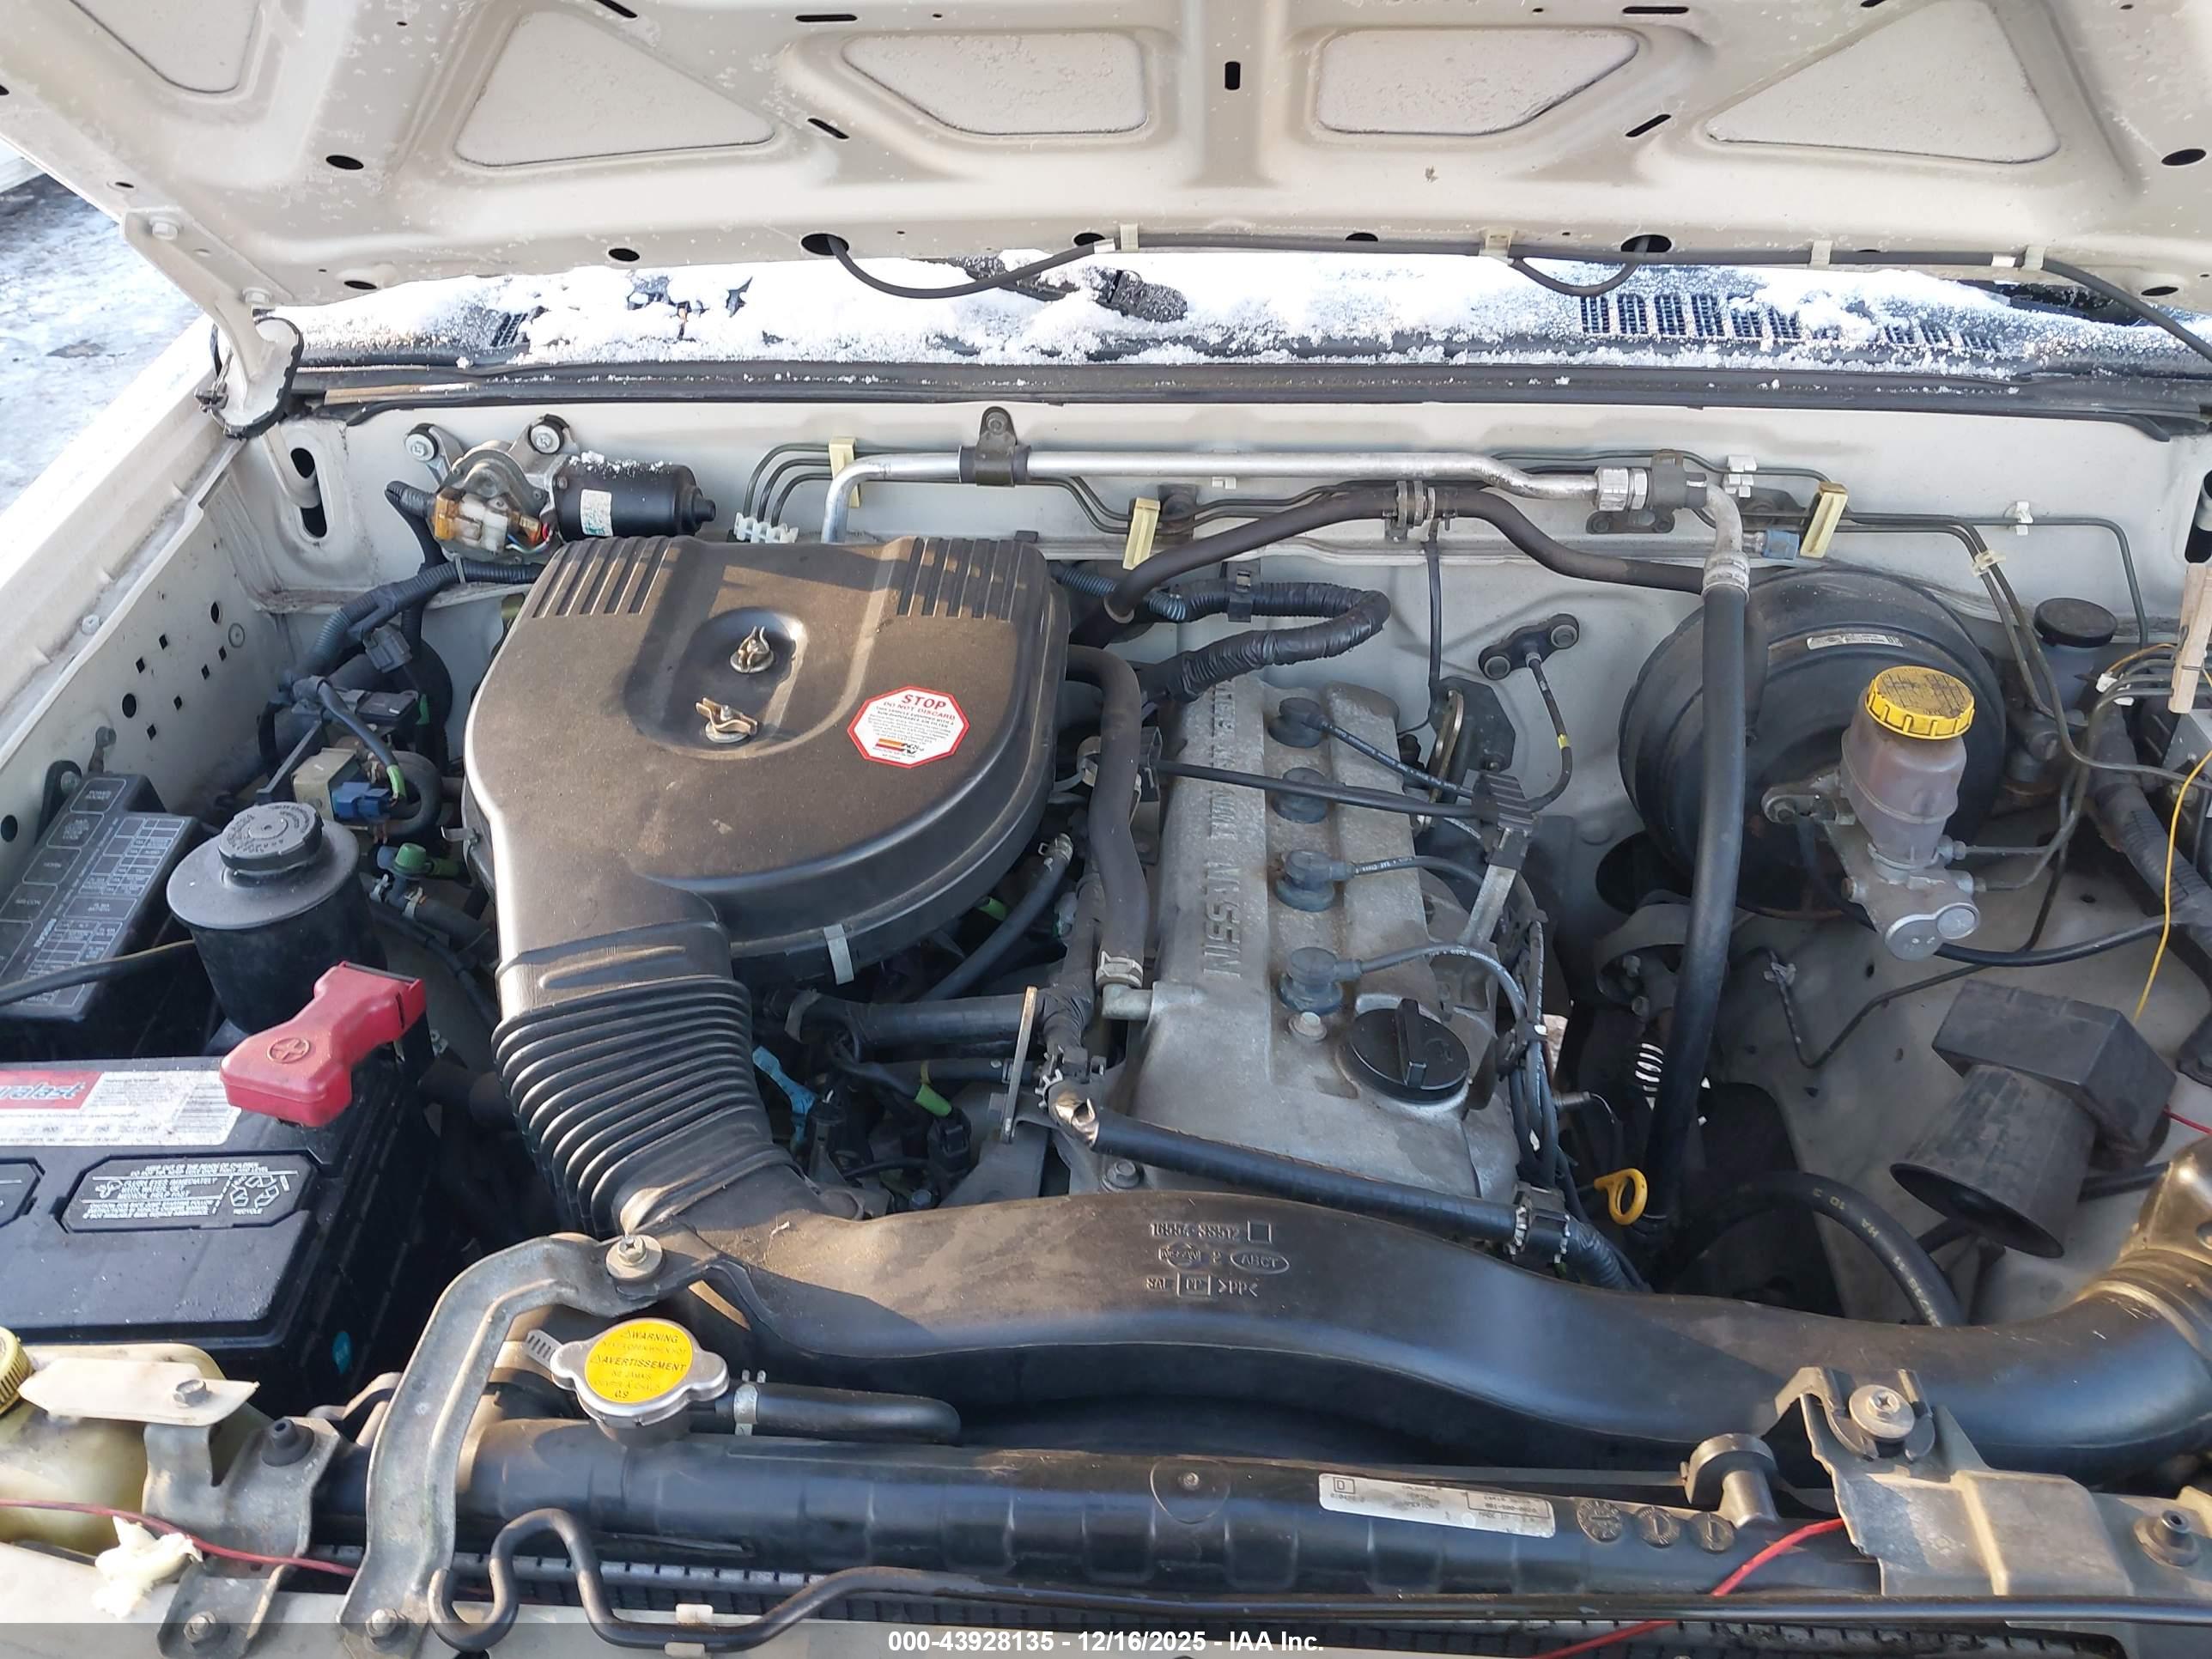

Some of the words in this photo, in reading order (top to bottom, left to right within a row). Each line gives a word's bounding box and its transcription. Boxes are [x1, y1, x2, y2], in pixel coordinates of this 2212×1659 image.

[902, 694, 946, 709] STOP
[883, 701, 896, 709] DO
[917, 708, 956, 720] DISCARD
[1203, 860, 1241, 978] NISSAN
[632, 1329, 679, 1344] WARNING
[601, 1356, 687, 1372] AVERTISSEMENT
[1336, 1480, 1346, 1491] D
